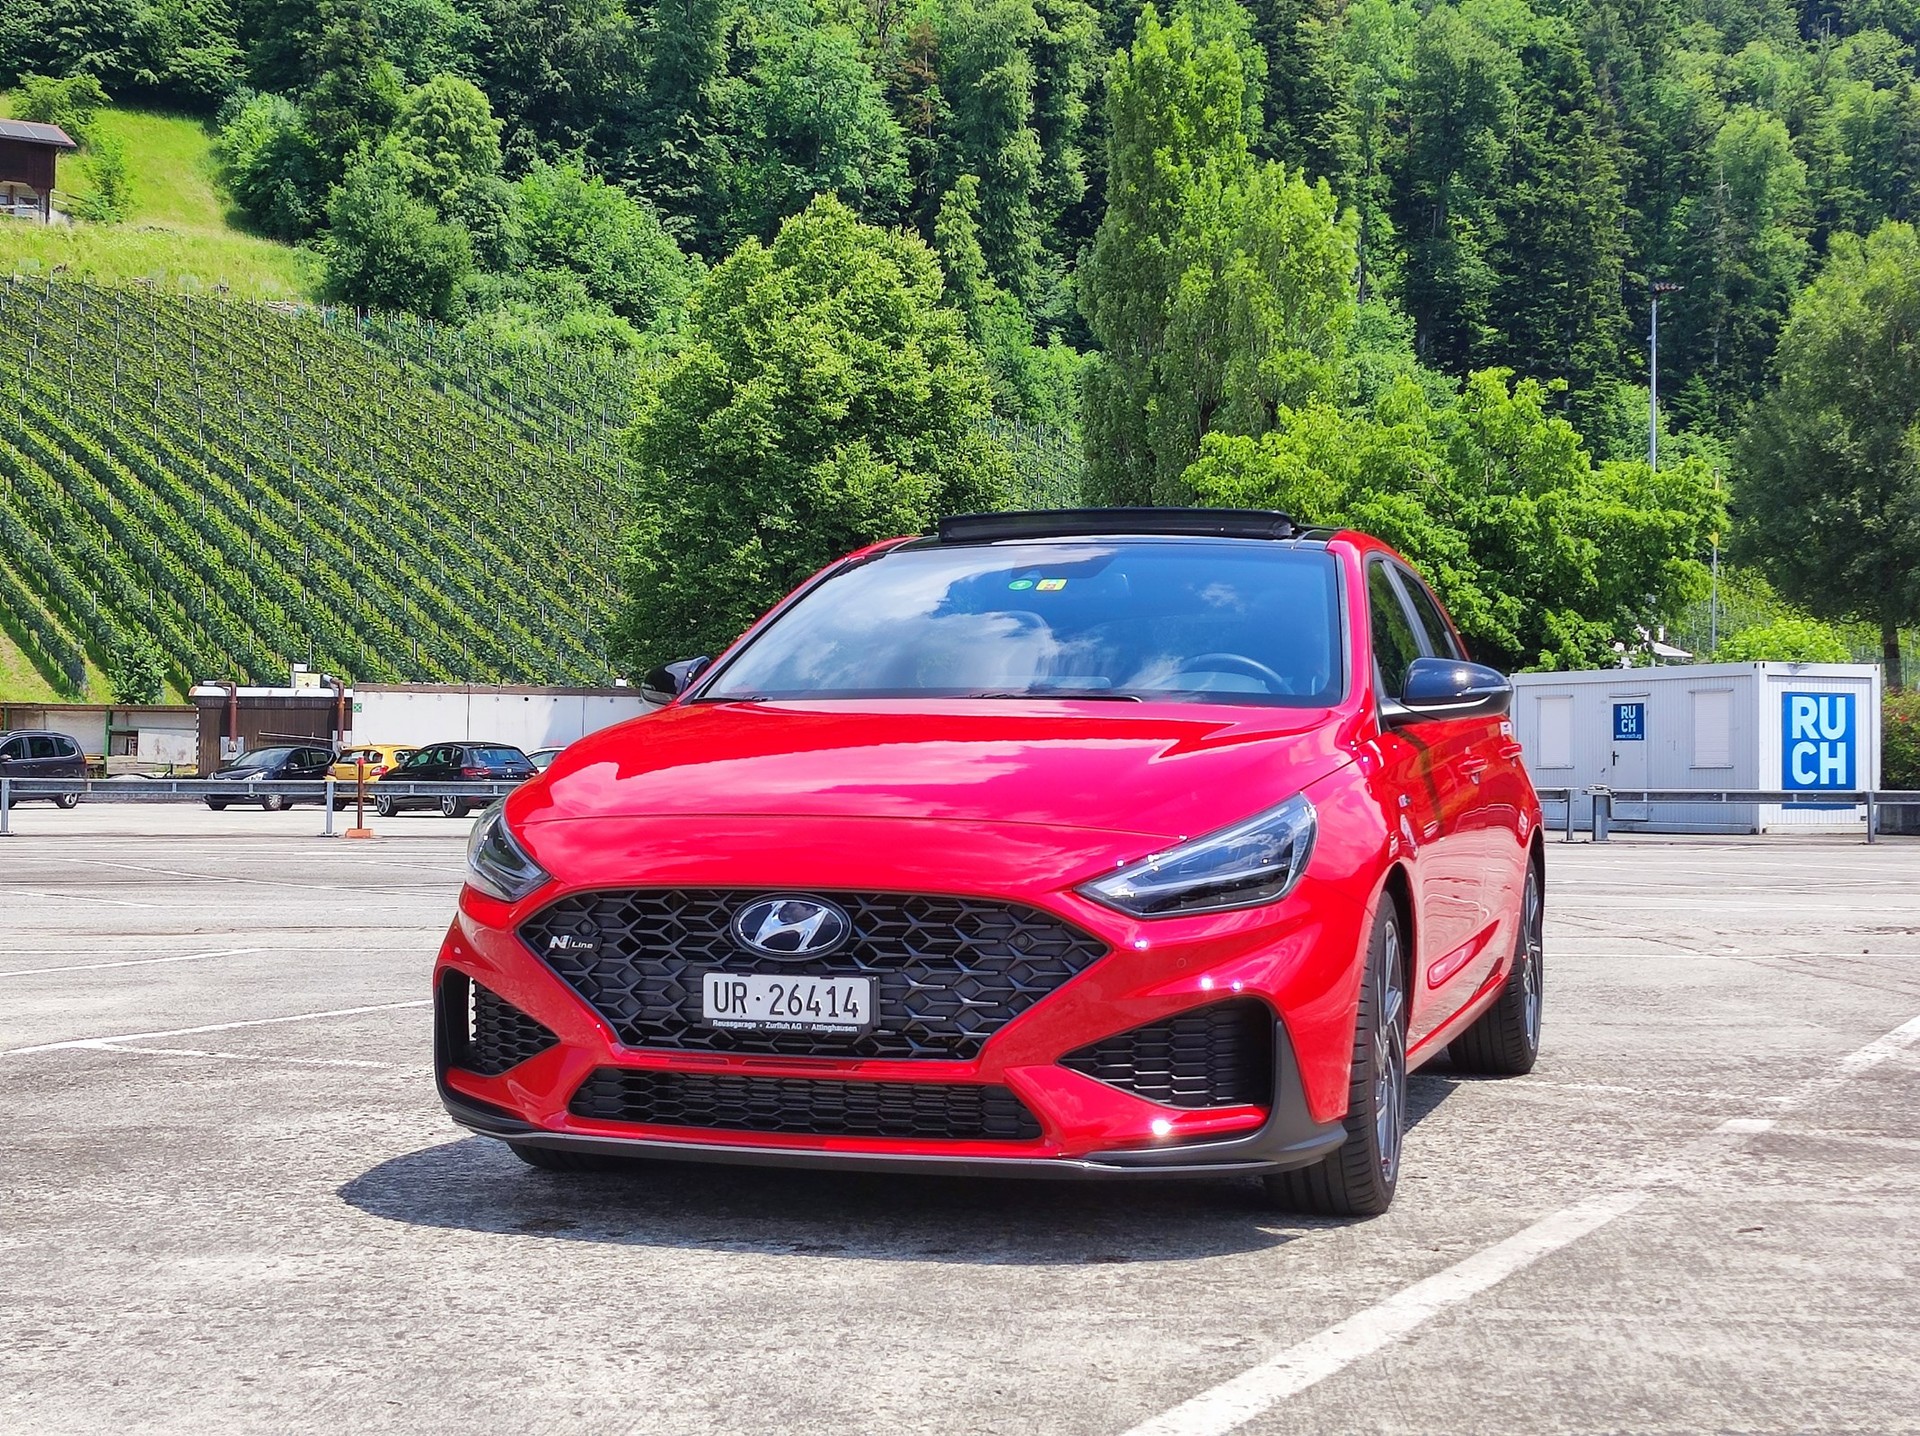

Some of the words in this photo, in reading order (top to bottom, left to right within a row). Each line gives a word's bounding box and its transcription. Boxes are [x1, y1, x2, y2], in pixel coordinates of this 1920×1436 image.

[1621, 705, 1636, 719] RU
[1621, 719, 1636, 732] CH
[1791, 695, 1846, 740] RU
[1791, 741, 1847, 785] CH
